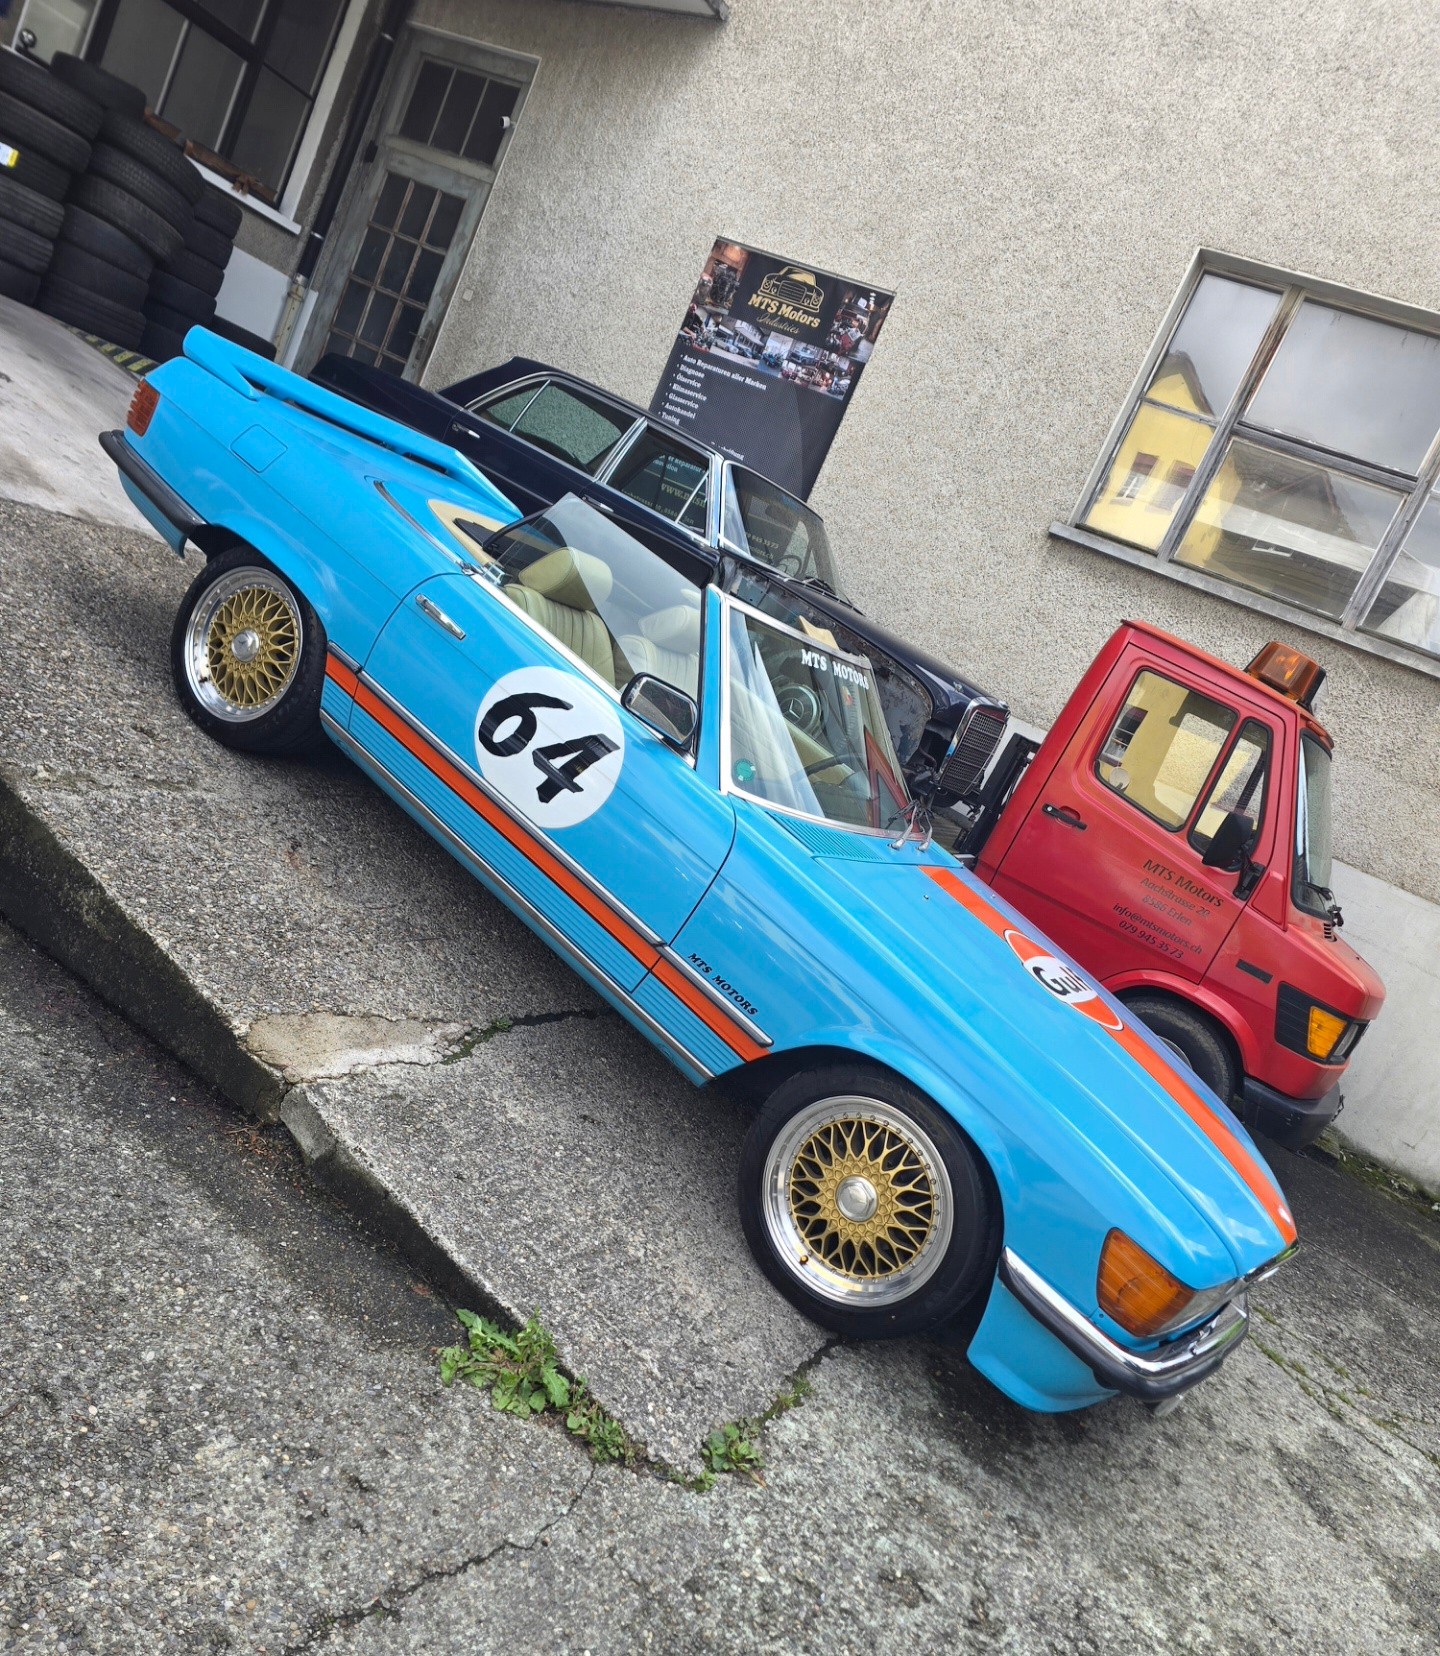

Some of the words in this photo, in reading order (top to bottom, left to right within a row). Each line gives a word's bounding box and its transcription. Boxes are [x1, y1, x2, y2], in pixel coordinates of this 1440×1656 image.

[748, 293, 779, 314] MTS
[777, 303, 821, 328] Motors
[757, 312, 800, 334] Industries
[680, 364, 705, 379] Diagnose
[683, 354, 697, 365] Auto
[696, 359, 731, 377] Reparaturen
[731, 372, 745, 382] aller
[744, 376, 767, 390] Marken
[668, 392, 699, 409] Glasservice
[672, 382, 707, 401] Klimaservice
[661, 411, 680, 425] Tuning
[665, 402, 697, 419] Autohandel
[801, 648, 828, 671] MTS
[832, 660, 870, 690] MOTORS
[478, 692, 621, 804] 64
[1140, 877, 1196, 911] Aachstrasse
[1142, 859, 1176, 882] MTS
[1174, 875, 1225, 907] Motors
[1112, 903, 1203, 955] info@mtsmotors.ch
[1166, 907, 1192, 927] Erlen
[1119, 920, 1138, 934] 079
[1137, 929, 1157, 945] 945
[1158, 942, 1170, 952] 35
[1169, 948, 1184, 959] 73
[687, 953, 713, 974] MTS
[712, 974, 759, 1015] MOTORS
[1031, 965, 1093, 996] Gulf
